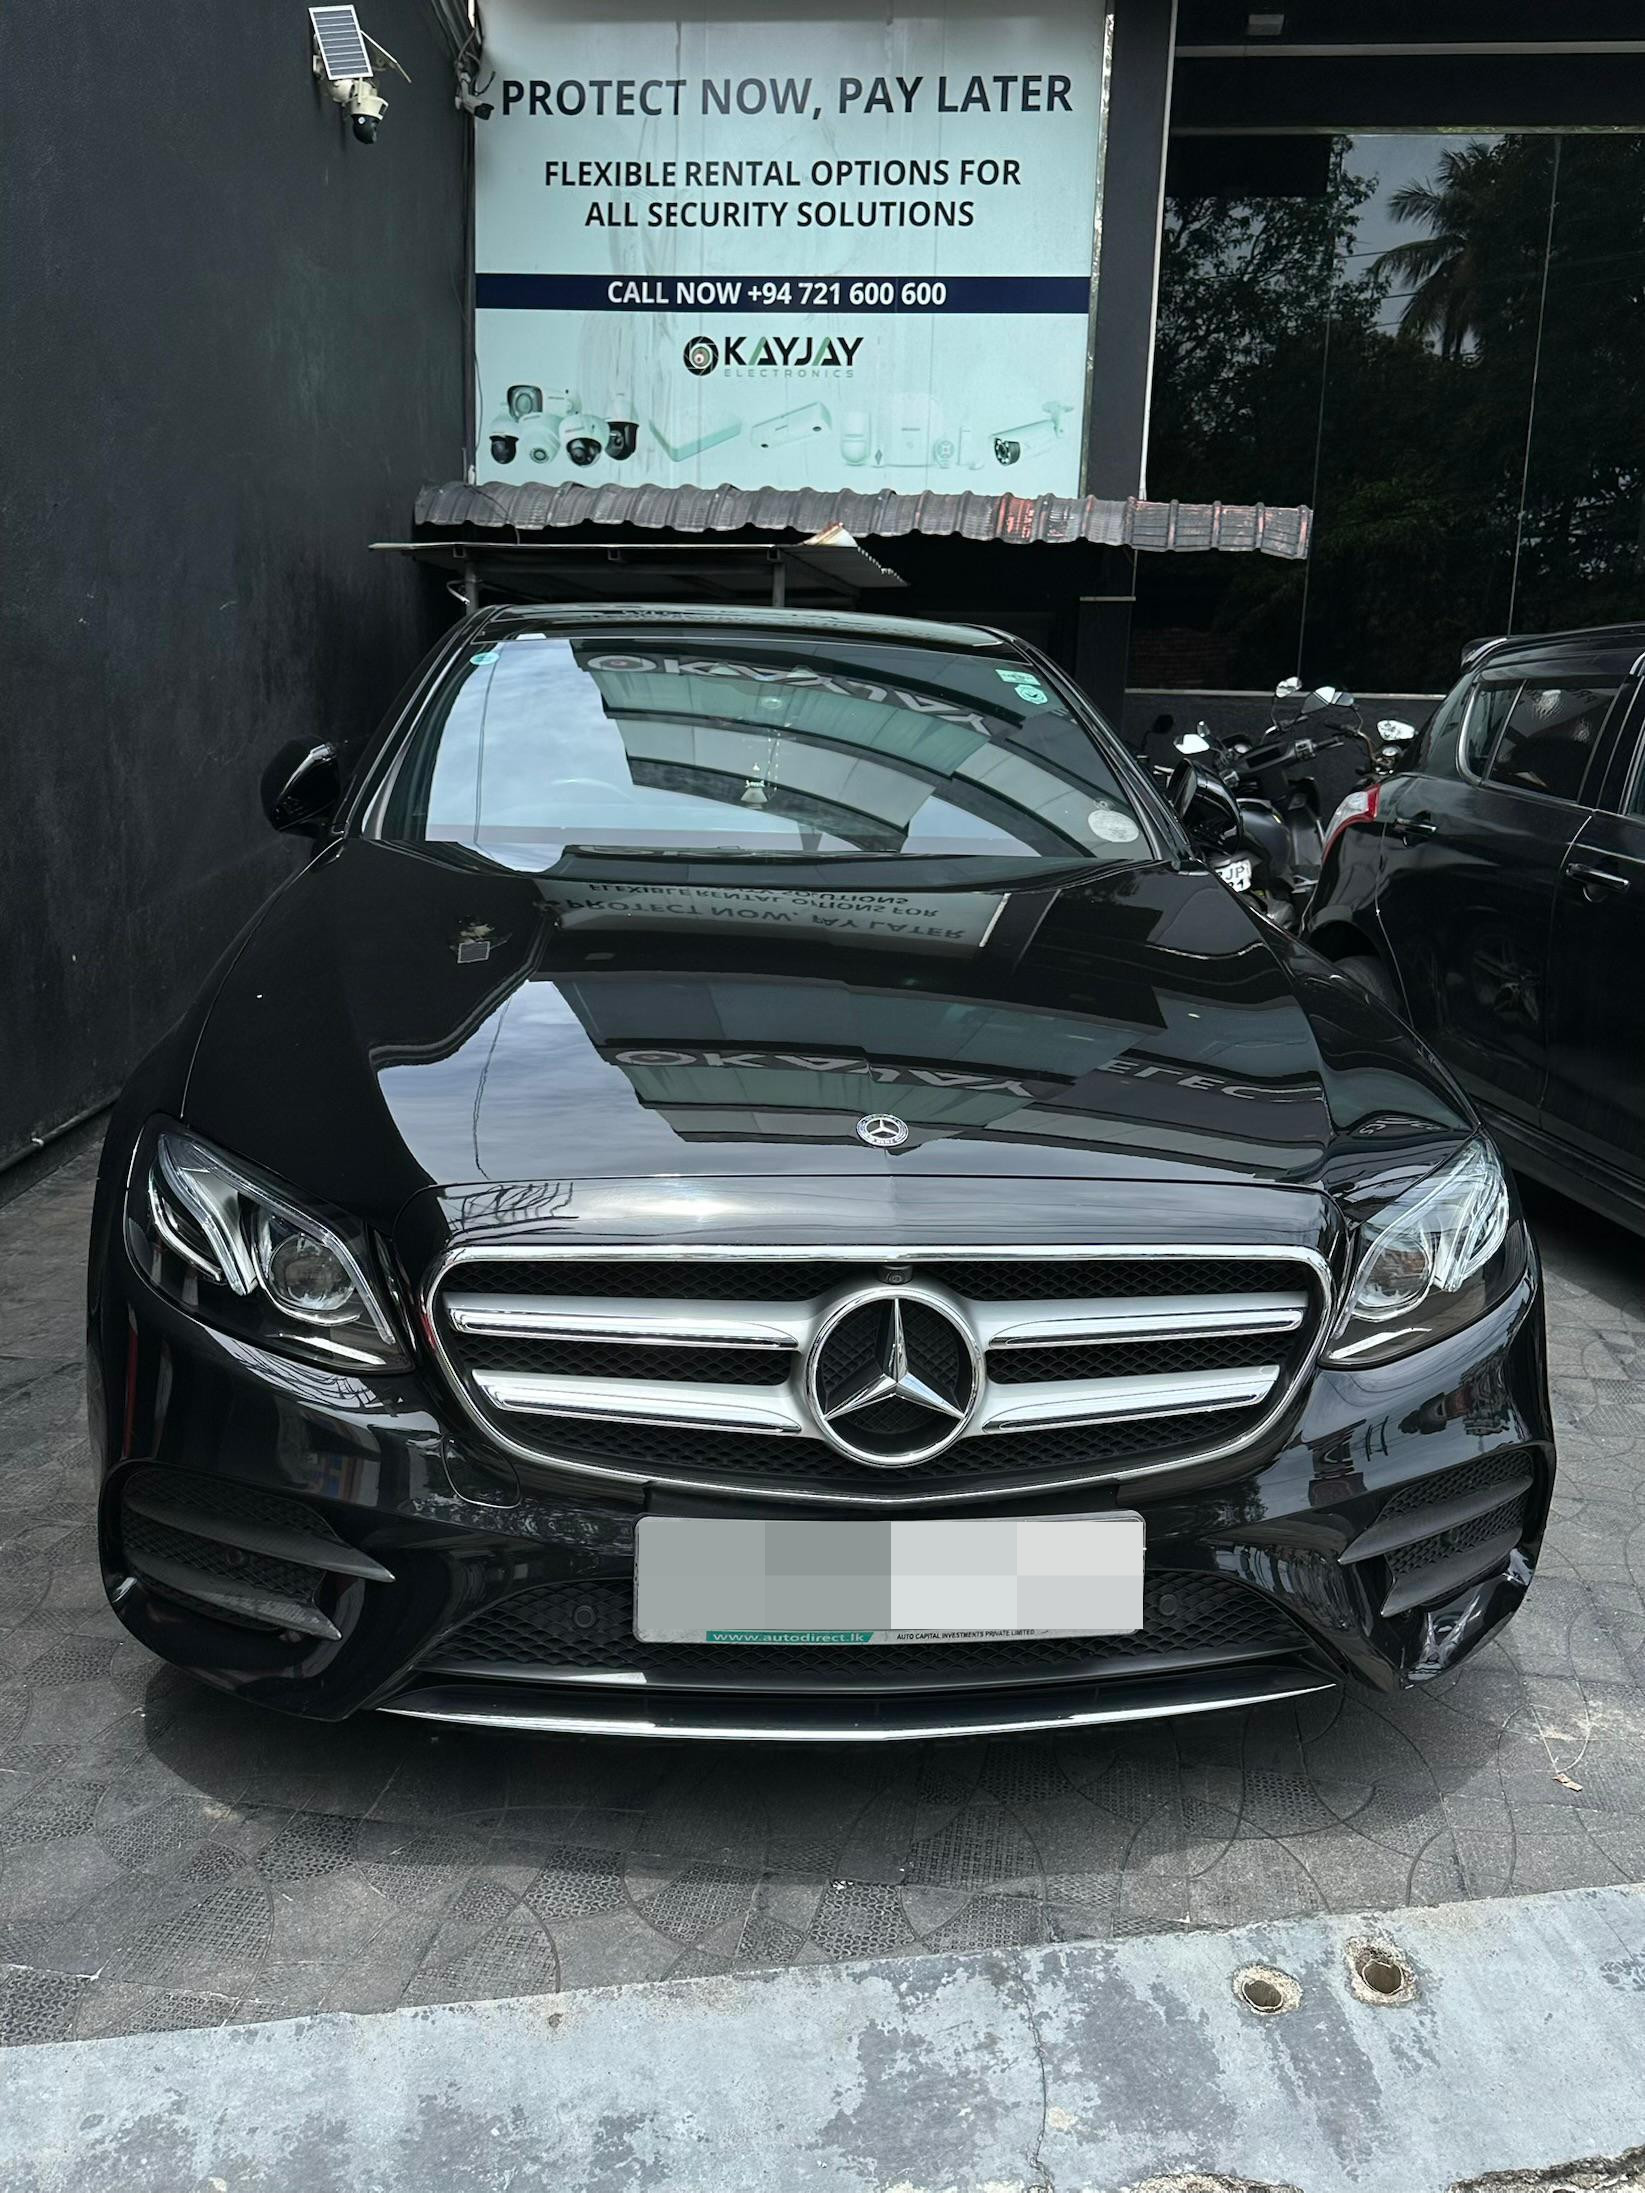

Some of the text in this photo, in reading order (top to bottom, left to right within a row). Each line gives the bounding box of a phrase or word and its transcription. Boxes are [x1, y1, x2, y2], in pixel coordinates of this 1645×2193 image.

[502, 74, 1074, 121] PROTECT NOW, PAY LATER
[545, 159, 1021, 187] FLEXIBLE RENTAL OPTIONS FOR
[584, 200, 975, 228] ALL SECURITY SOLUTIONS
[607, 281, 947, 306] CALL NOW +94 721 600 600
[724, 335, 865, 367] KAYJAY
[724, 368, 855, 379] ELECTRONICS
[712, 1632, 865, 1643] www.autodirect.lk
[896, 1628, 1036, 1641] AUTO CAPITAL INVESTMENTS PRIVATE LIMITED
